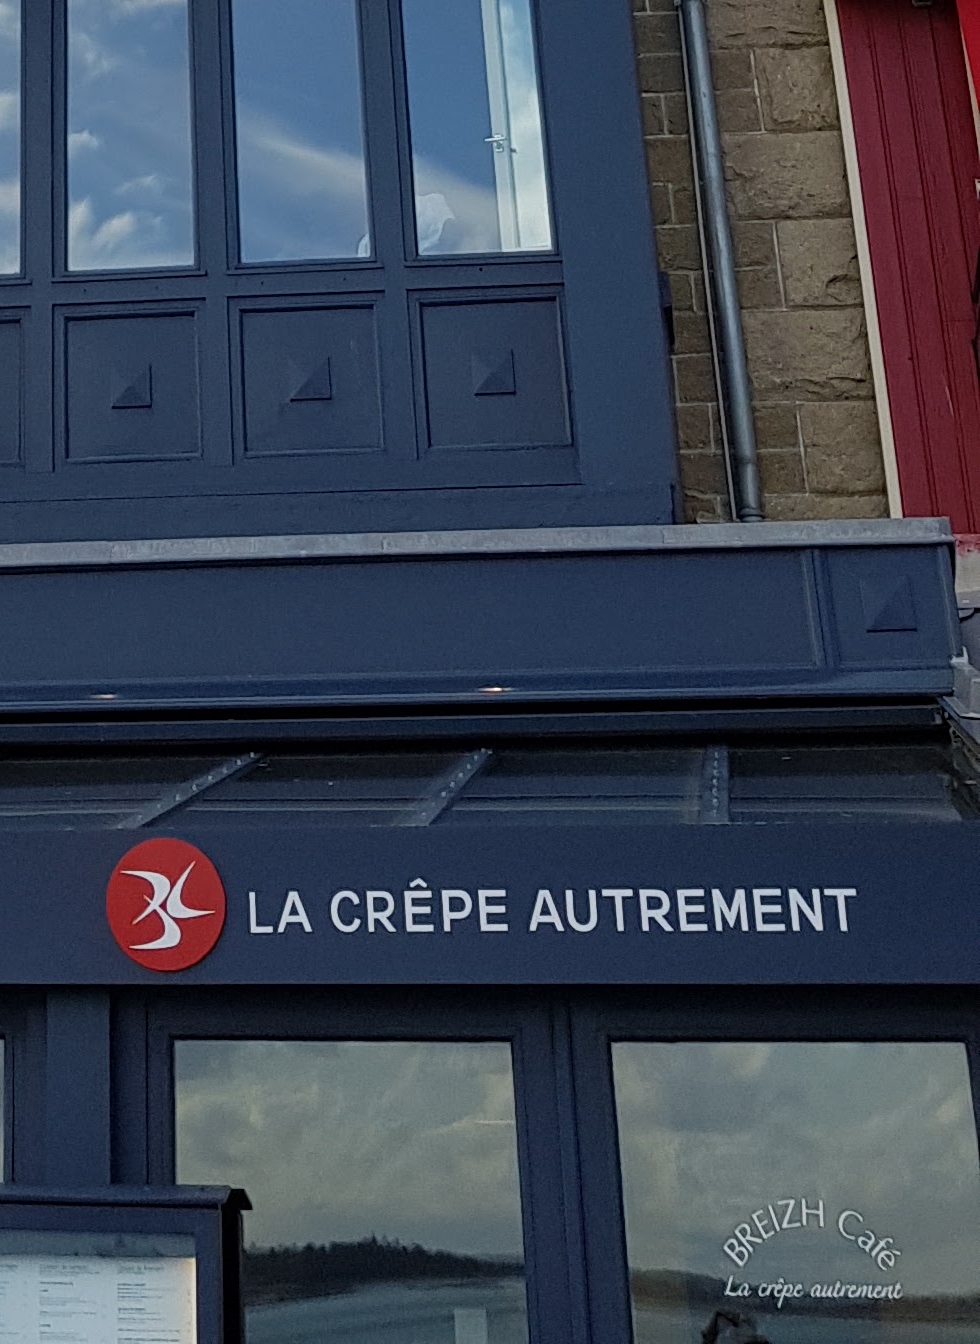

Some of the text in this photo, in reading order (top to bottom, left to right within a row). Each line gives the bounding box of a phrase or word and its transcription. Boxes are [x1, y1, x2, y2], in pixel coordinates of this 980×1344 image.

[249, 877, 857, 934] LA CRÊPE AUTREMENT
[723, 1198, 902, 1272] BREIZH Café
[724, 1274, 904, 1310] La crêpe autrement
